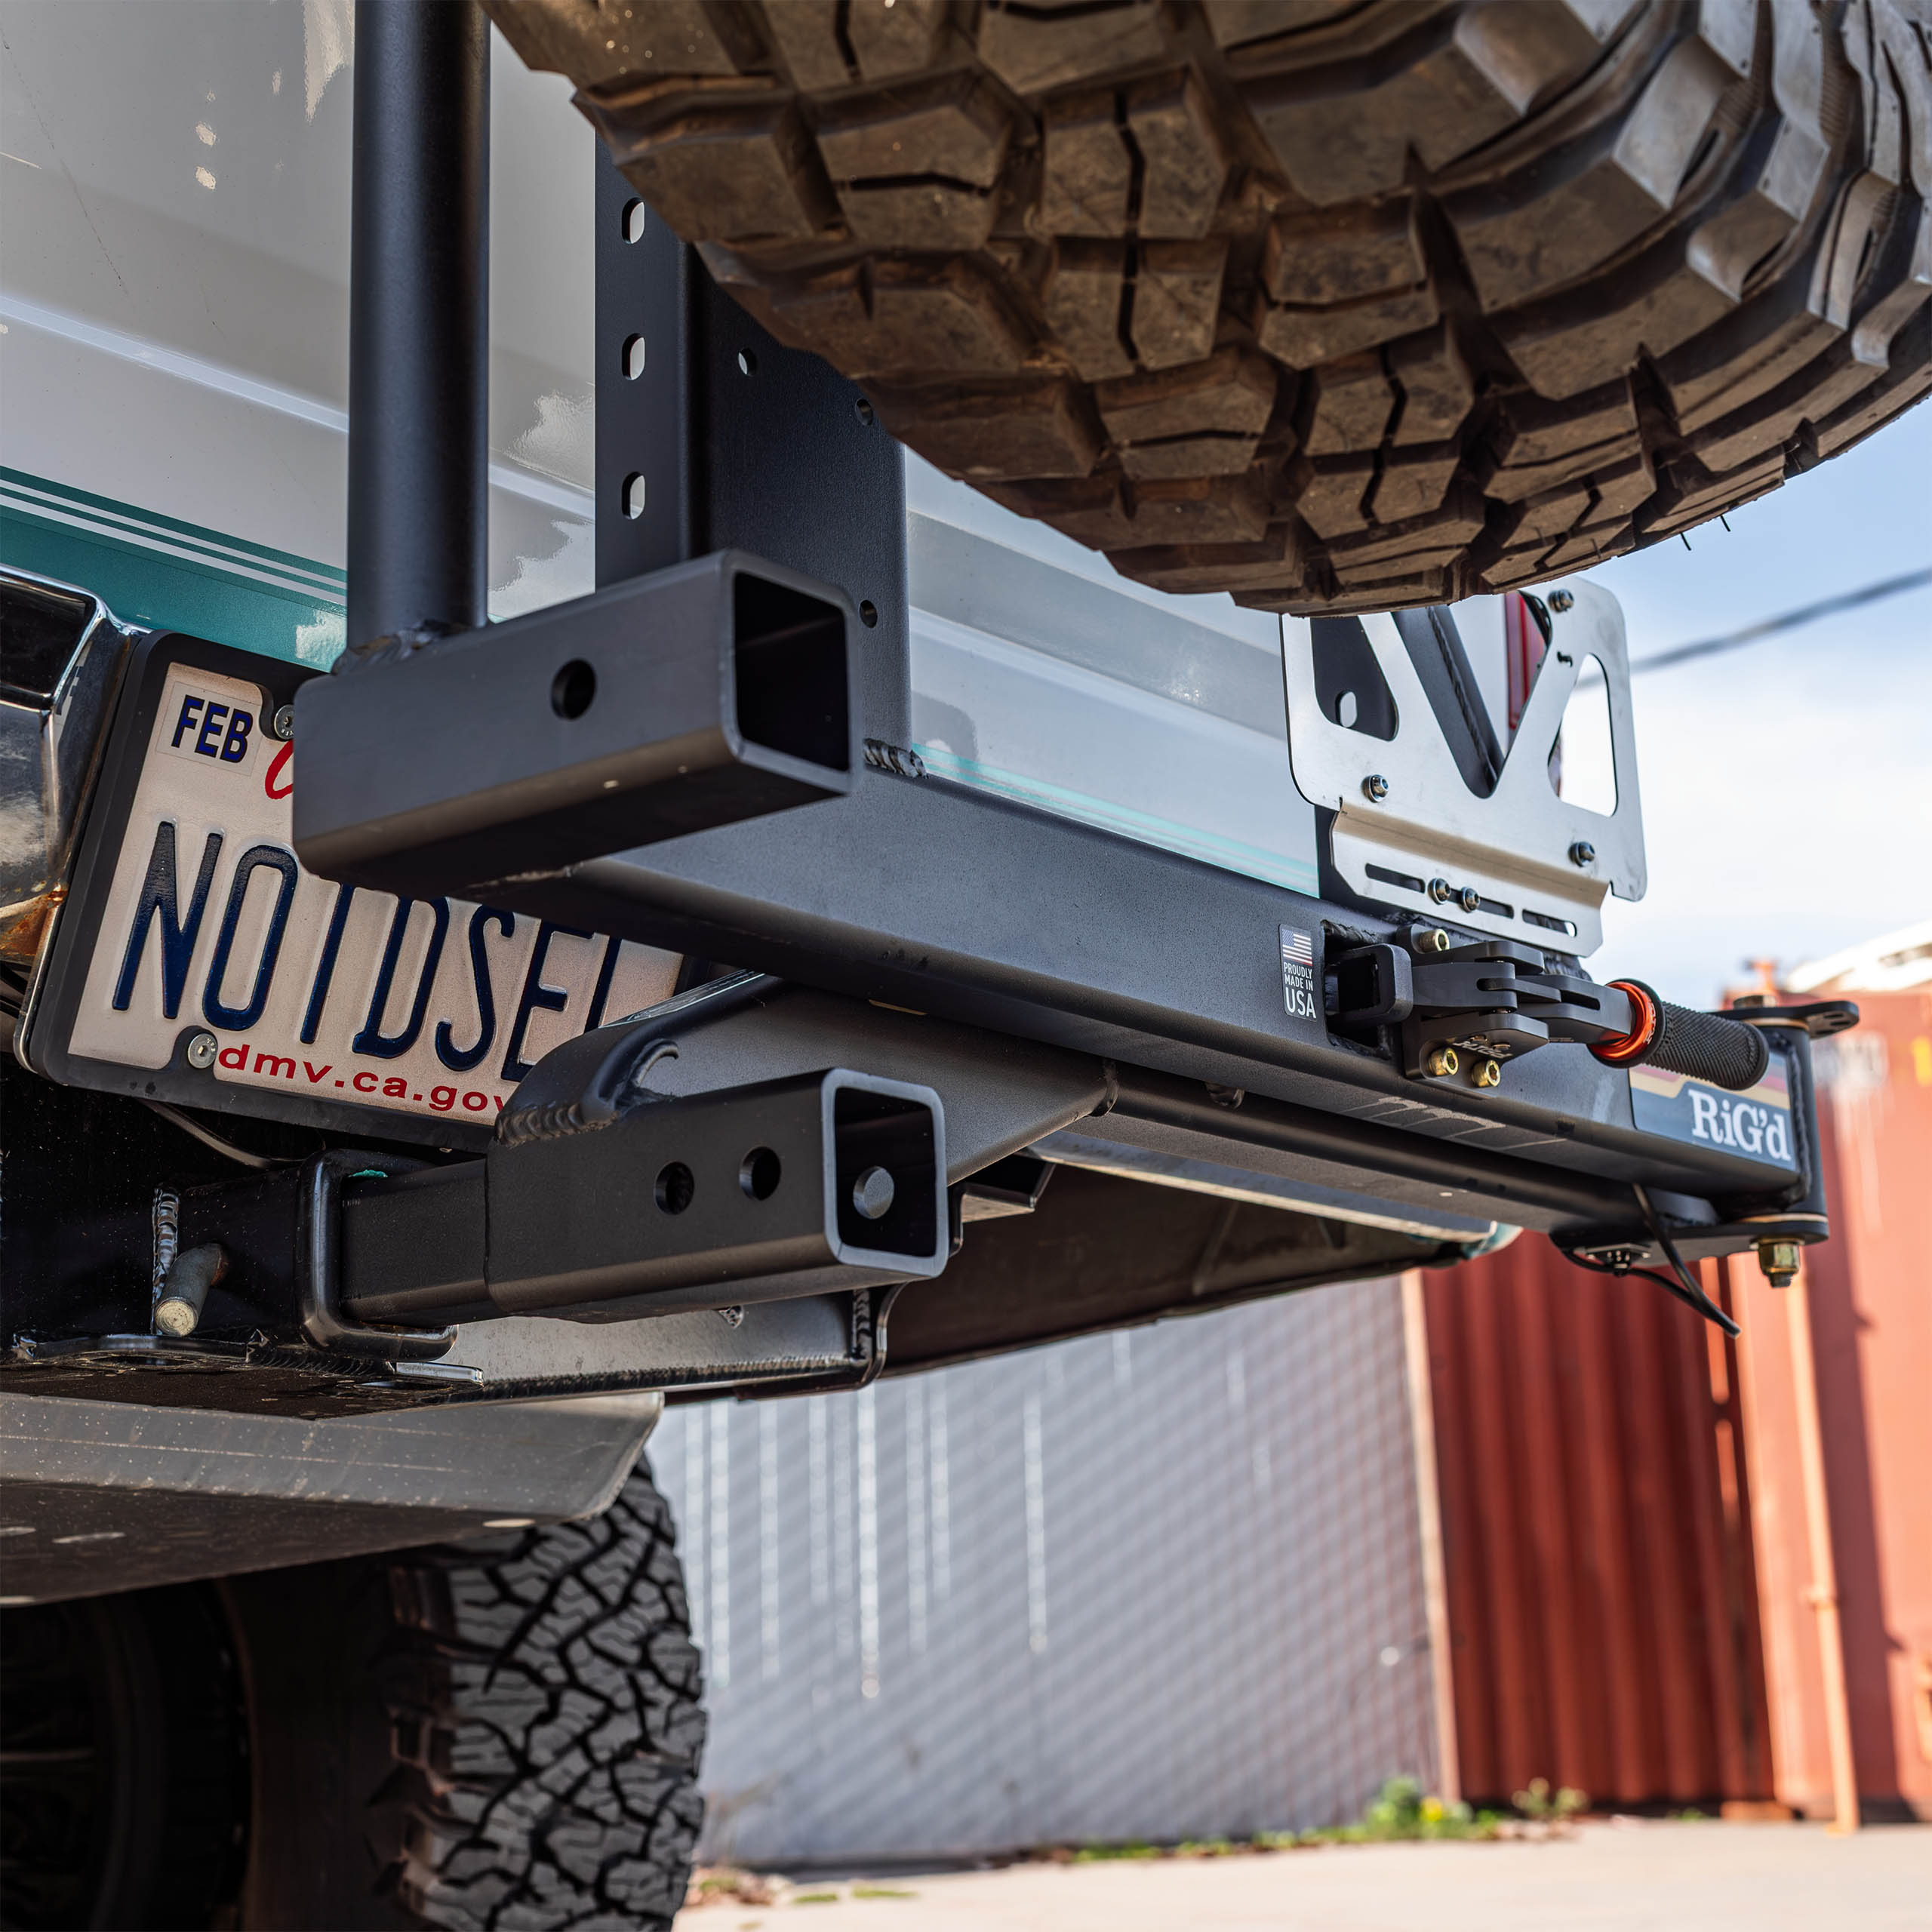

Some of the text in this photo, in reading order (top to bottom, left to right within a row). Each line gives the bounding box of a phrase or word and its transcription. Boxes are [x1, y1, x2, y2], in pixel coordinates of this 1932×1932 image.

[171, 694, 254, 764] FEB
[1284, 961, 1312, 980] PROUDLY
[1284, 974, 1314, 992] MADE IN
[1285, 986, 1317, 1019] USA
